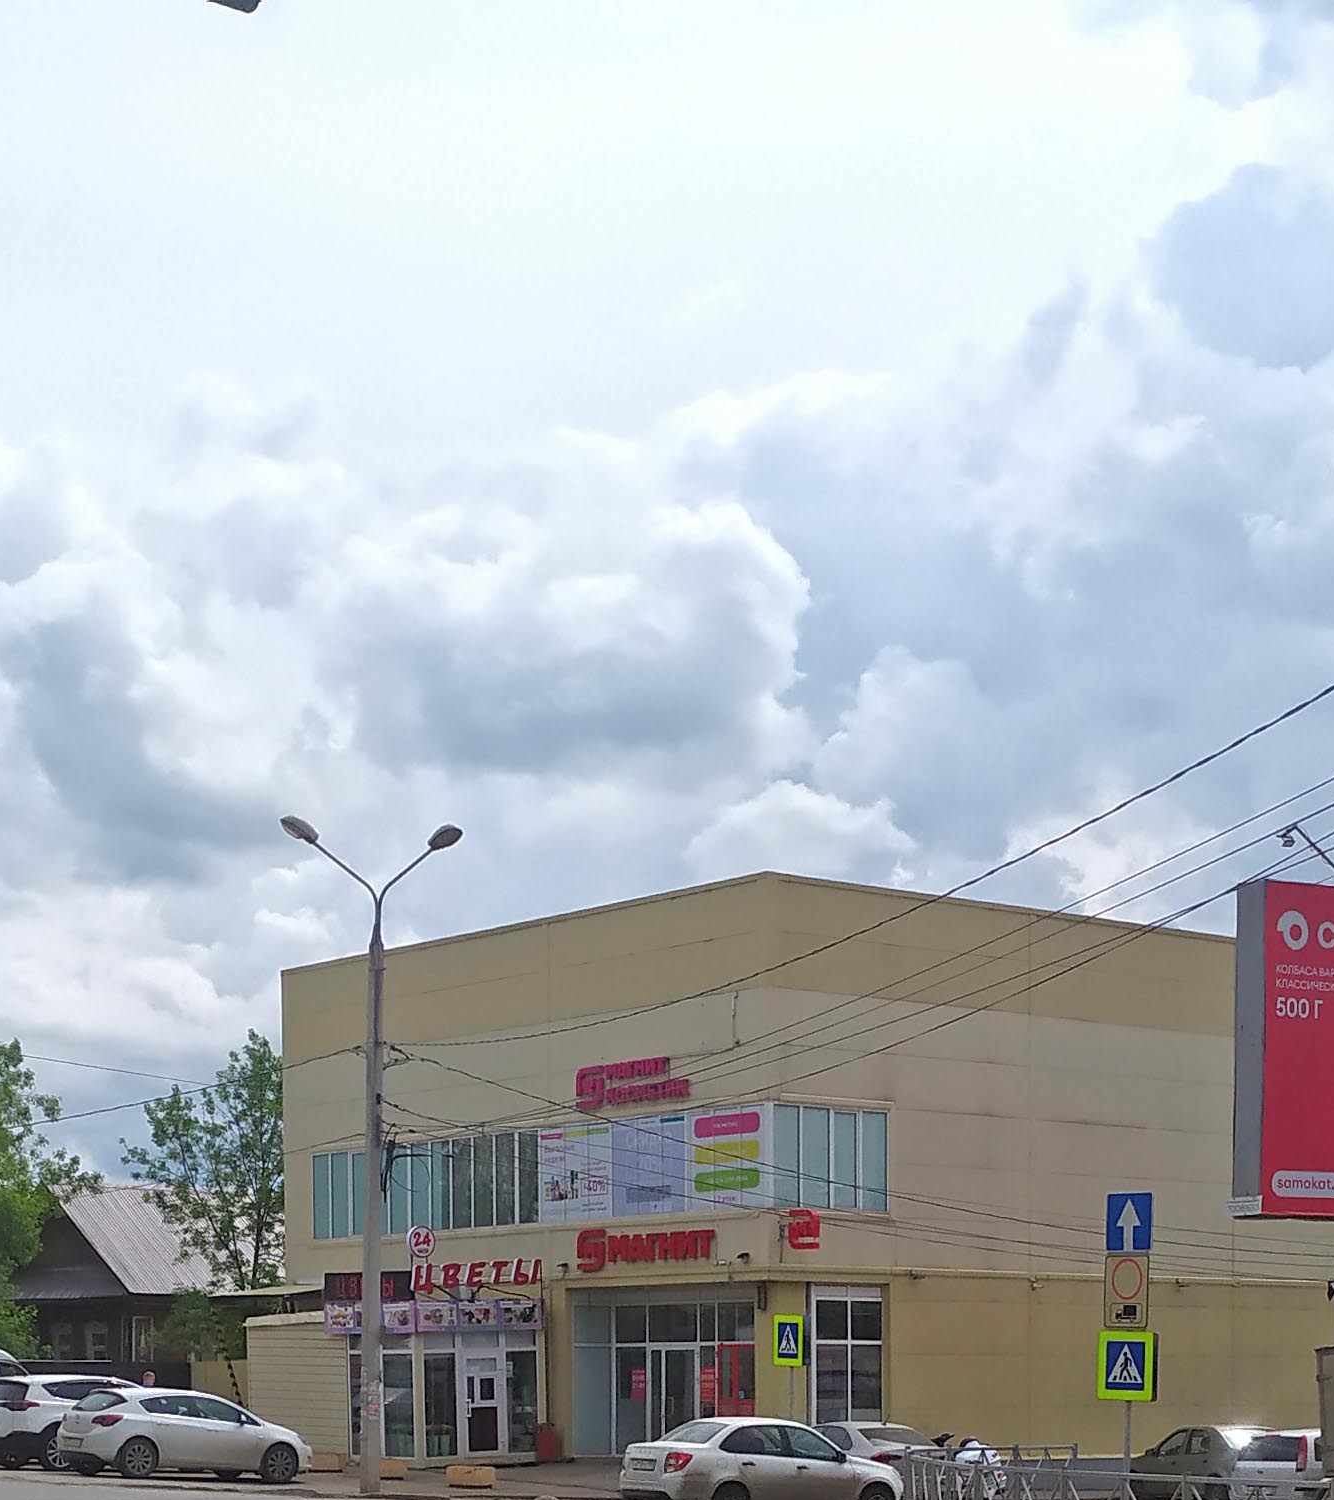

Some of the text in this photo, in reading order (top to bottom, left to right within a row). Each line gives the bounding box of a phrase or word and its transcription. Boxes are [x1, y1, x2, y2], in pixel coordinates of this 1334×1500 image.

[1276, 964, 1317, 976] КОЛБАСА
[1276, 997, 1323, 1019] 500 Г
[605, 1057, 670, 1080] МАГНИТ
[413, 1231, 431, 1247] 24
[608, 1229, 716, 1263] МАГНИТ
[337, 1277, 395, 1298] ЦВЫ
[412, 1258, 542, 1295] ЦВЕТЫ
